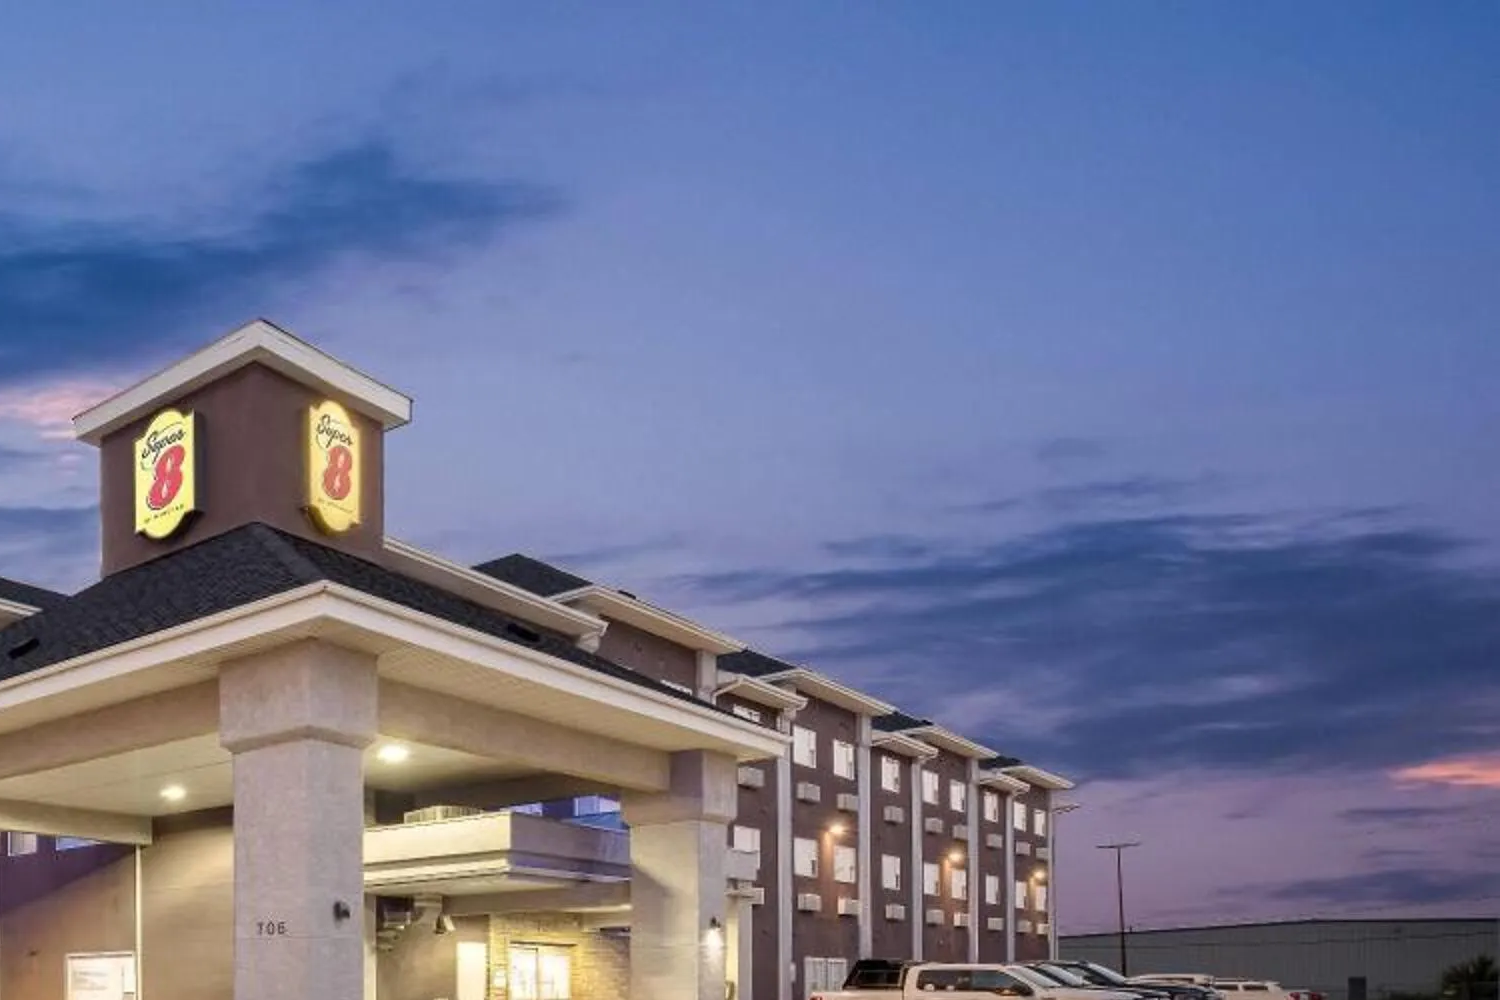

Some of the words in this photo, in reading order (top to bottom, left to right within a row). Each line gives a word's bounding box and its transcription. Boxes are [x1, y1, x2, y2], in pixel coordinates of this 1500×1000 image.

[316, 413, 354, 449] Super
[145, 443, 186, 511] 8
[321, 445, 353, 501] 8
